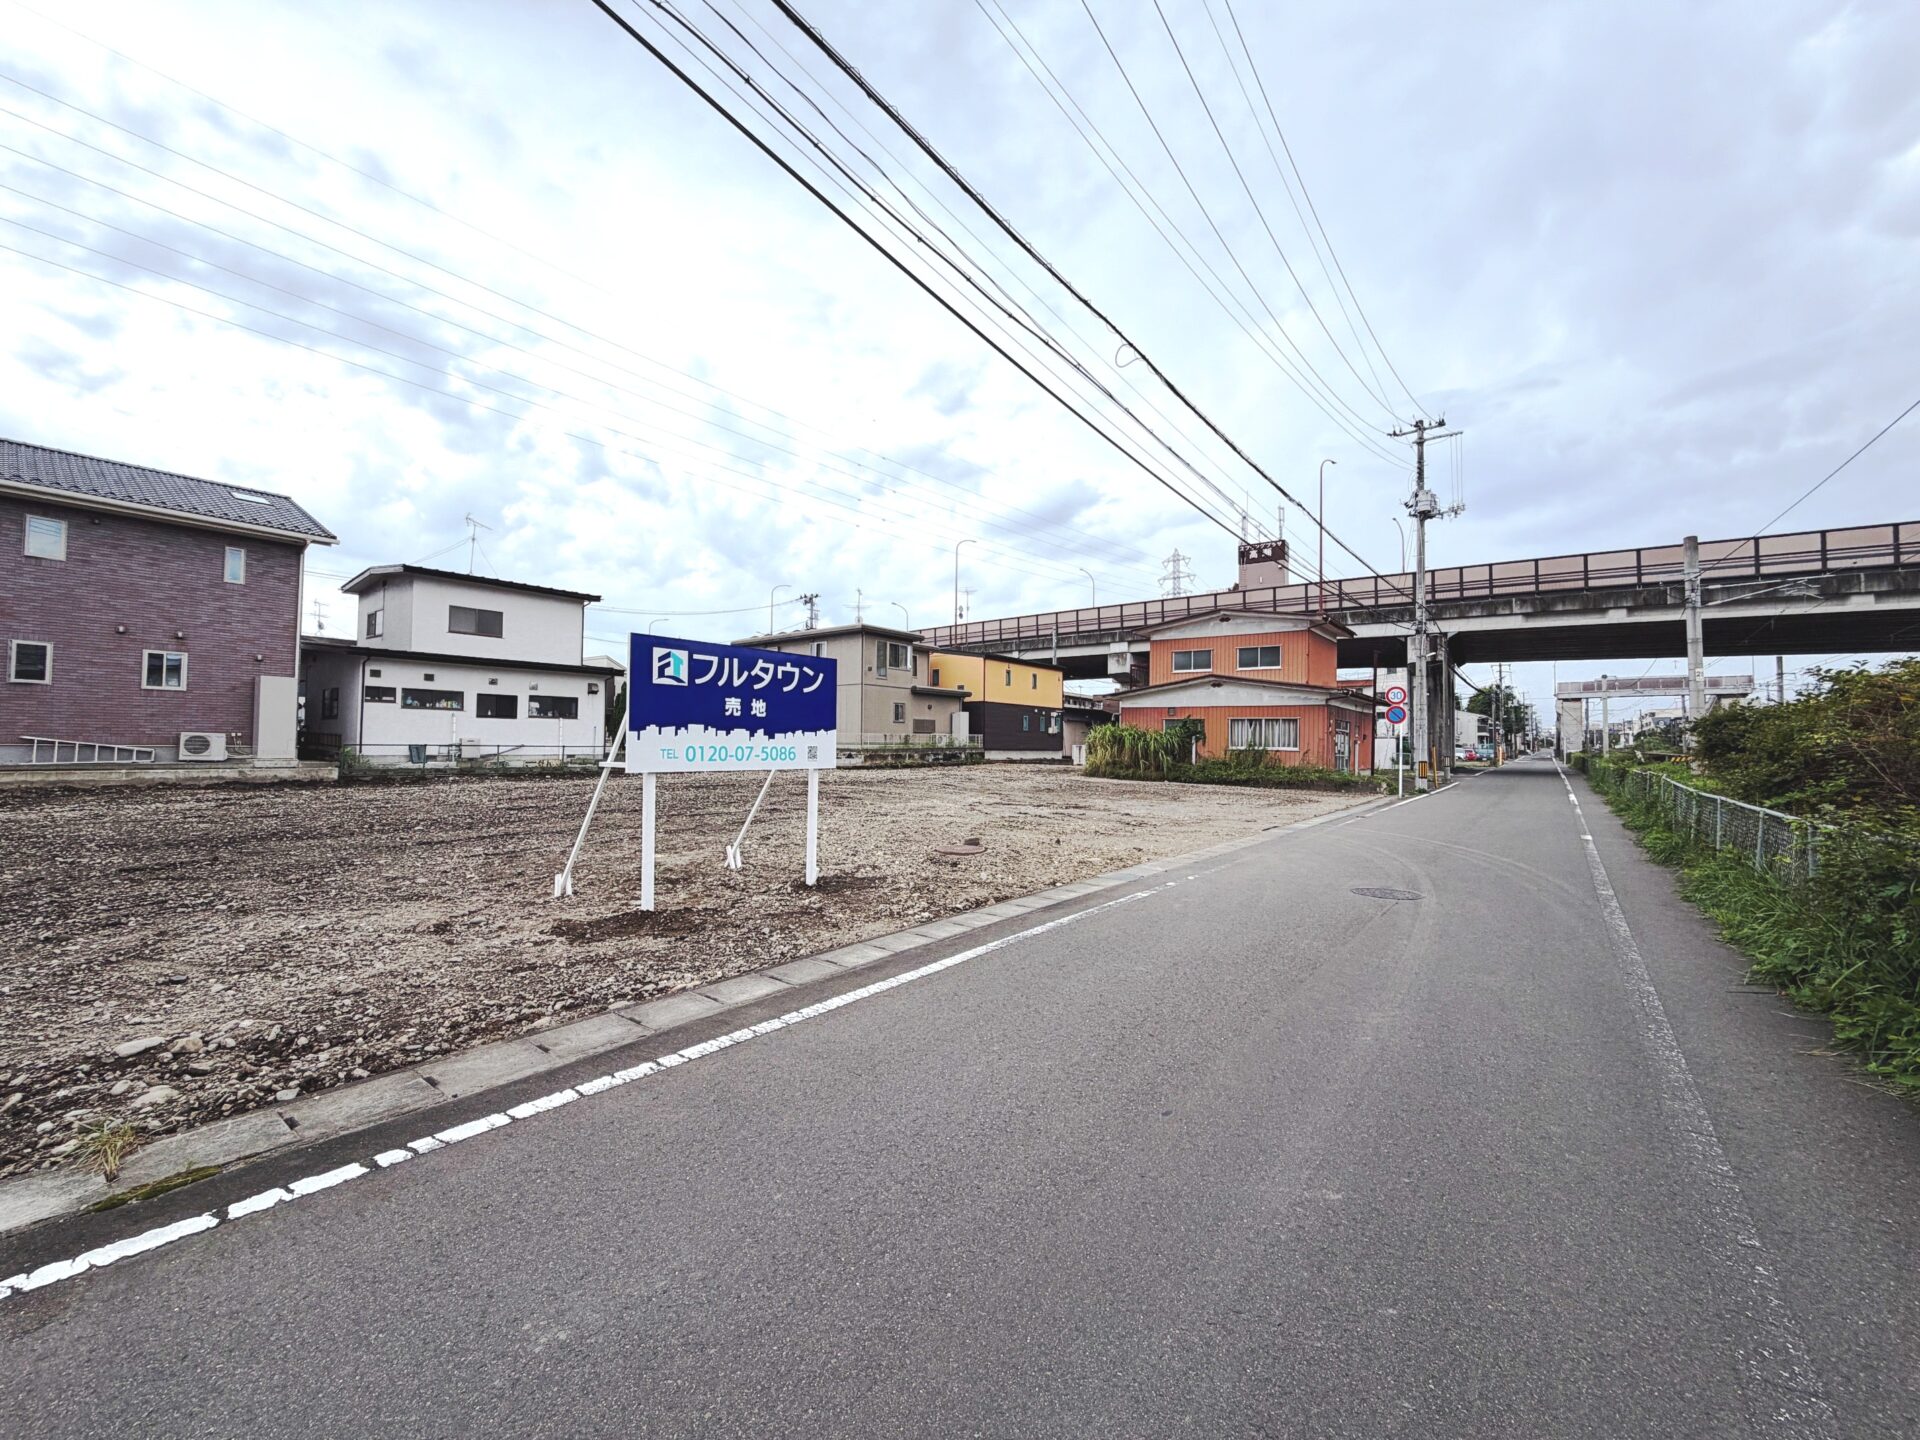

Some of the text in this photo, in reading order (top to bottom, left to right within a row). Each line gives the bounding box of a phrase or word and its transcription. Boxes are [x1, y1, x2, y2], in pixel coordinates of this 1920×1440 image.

[692, 653, 824, 693] フルタウン
[1390, 692, 1402, 700] 30
[724, 697, 767, 717] 売地
[660, 745, 796, 763] TEL 0120-07-5086
